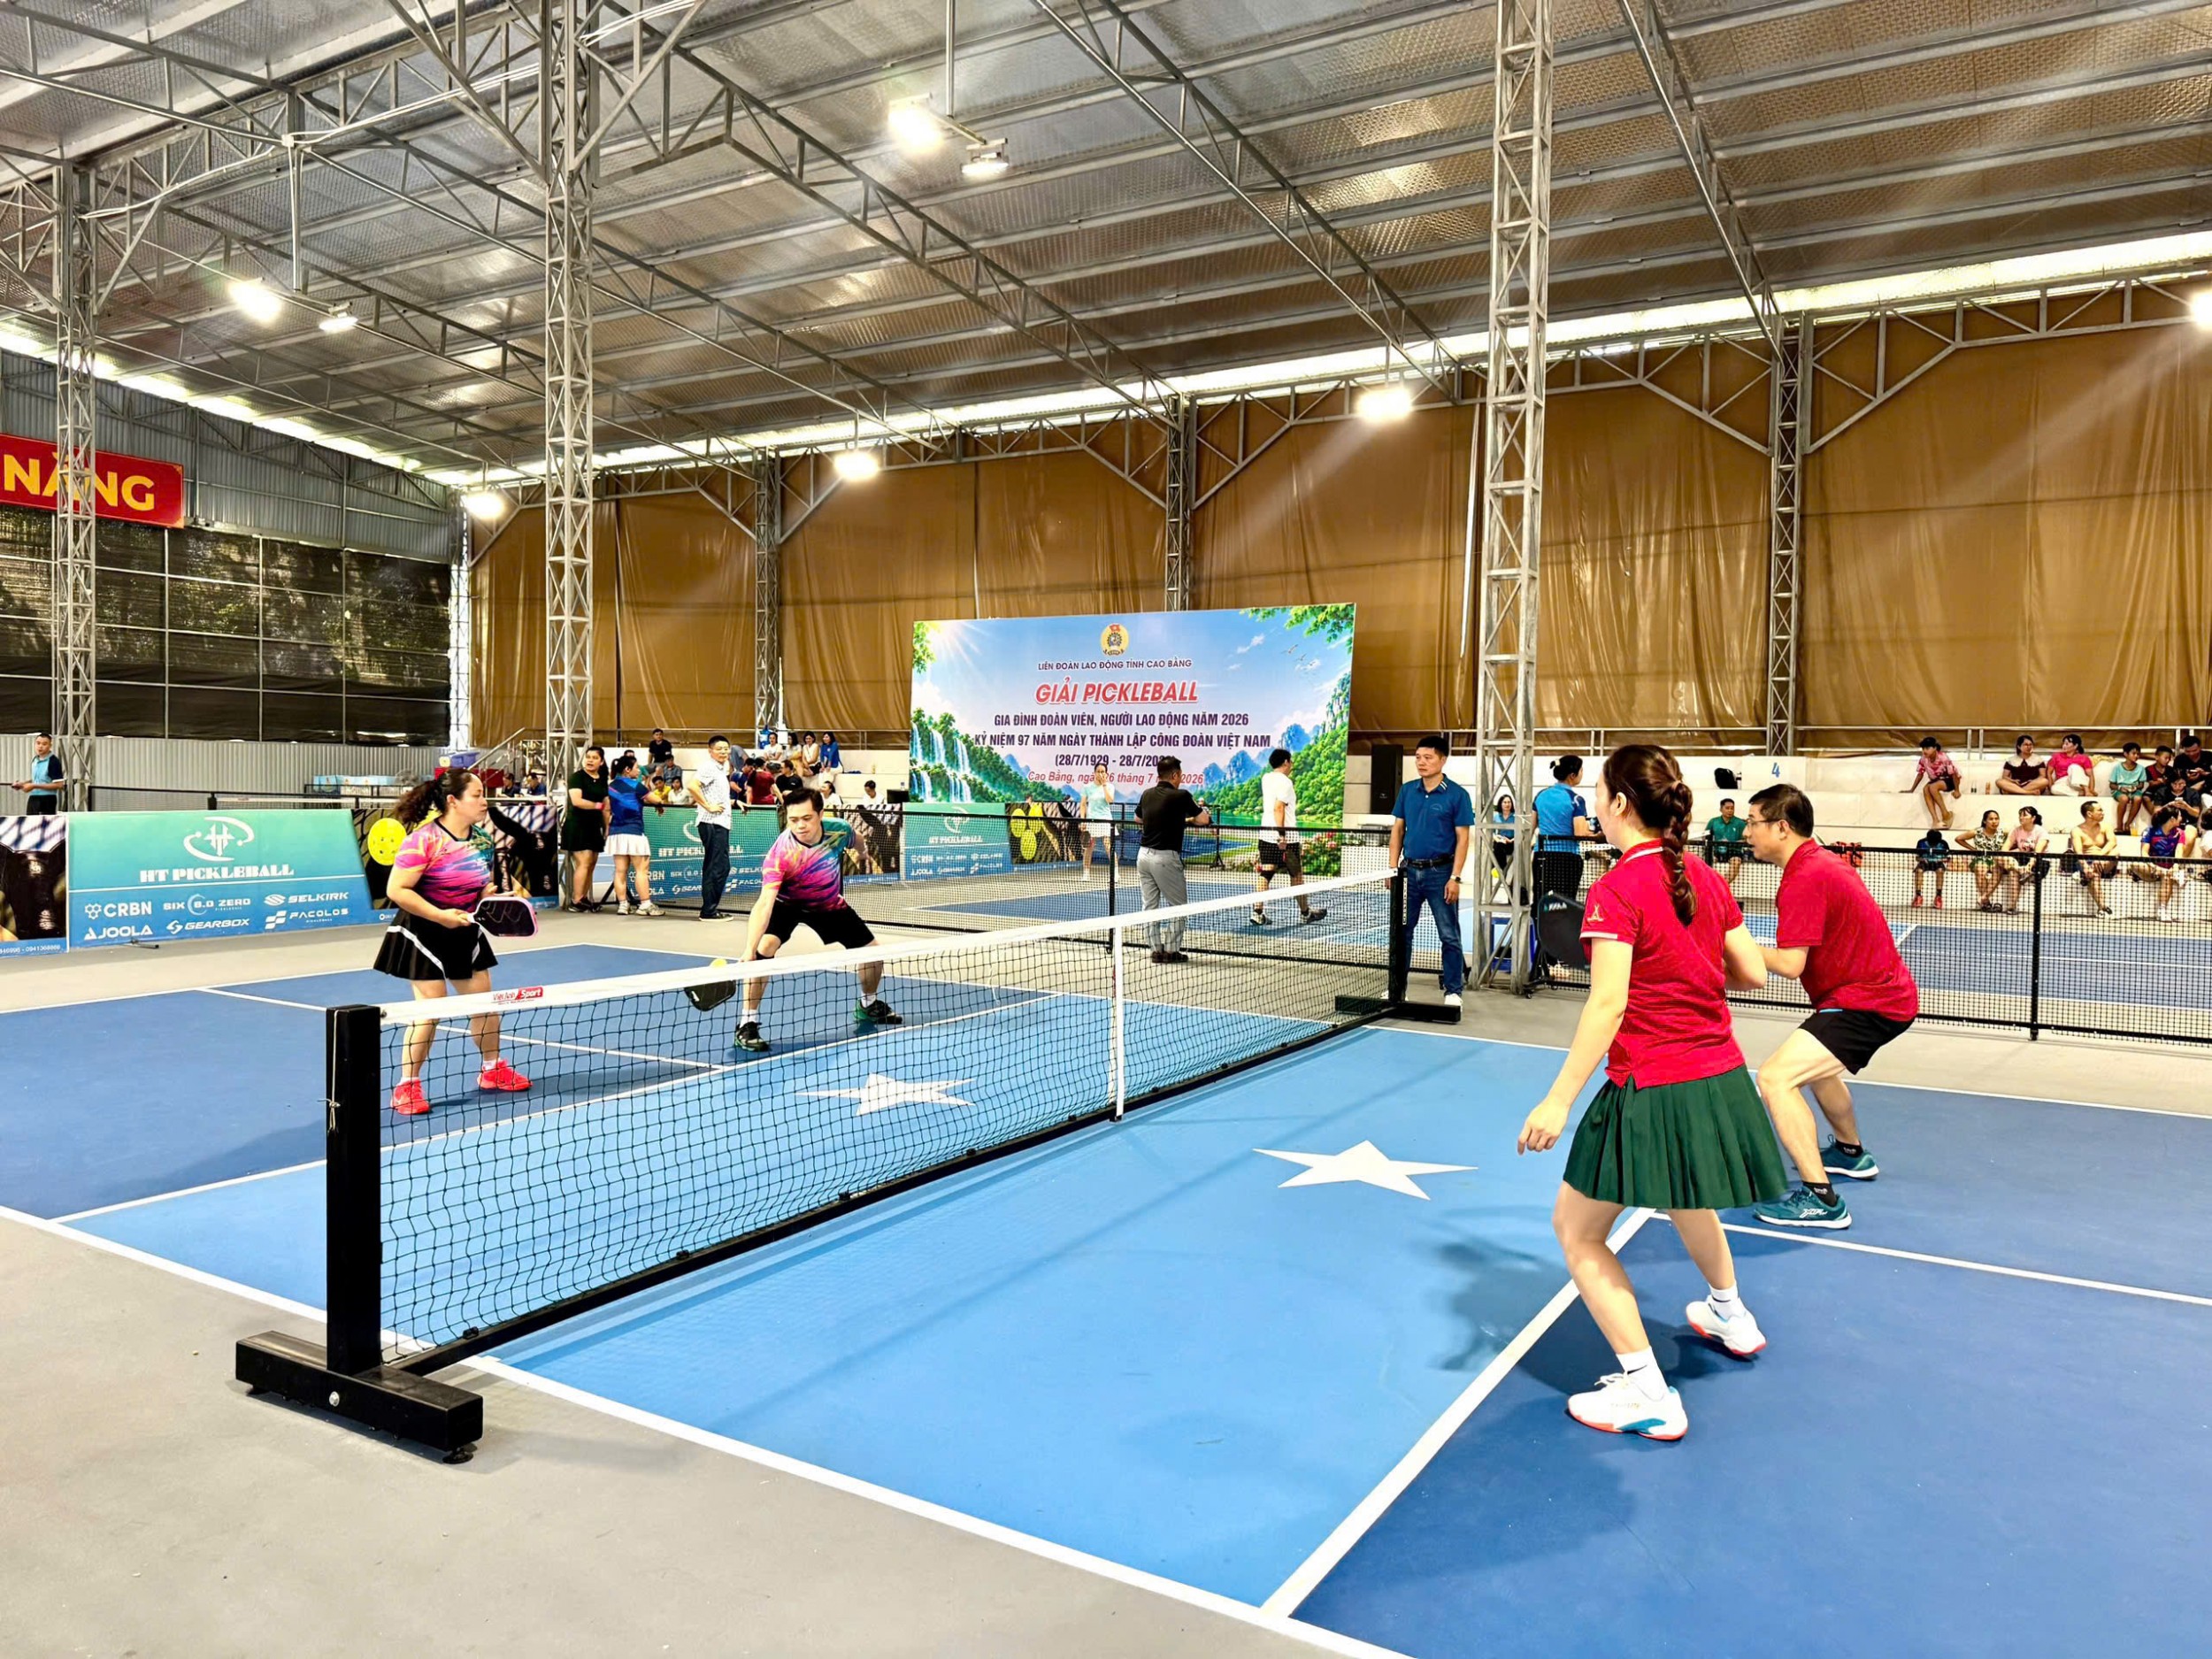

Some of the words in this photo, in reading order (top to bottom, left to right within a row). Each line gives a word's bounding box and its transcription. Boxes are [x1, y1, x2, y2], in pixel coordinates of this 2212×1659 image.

[1038, 661, 1054, 671] LIÊN
[1056, 660, 1079, 670] ĐOÀN
[1099, 659, 1124, 672] ĐỘNG
[1035, 677, 1079, 704] GIẢI
[1083, 681, 1199, 704] PICKLEBALL
[995, 714, 1010, 726] GIA
[1013, 711, 1037, 726] ĐÌNH
[1040, 711, 1067, 726] ĐOÀN
[1071, 711, 1097, 727] VIÊN,
[1101, 710, 1133, 726] NGƯỜI
[1136, 714, 1156, 726] LAO
[1158, 711, 1188, 728] ĐỘNG
[1192, 711, 1218, 726] NĂM
[1221, 713, 1248, 726] 2026
[974, 730, 987, 746] KỶ
[990, 732, 1015, 748] NIỆM
[1018, 734, 1030, 746] 97
[1033, 733, 1056, 746] NĂM
[1059, 733, 1087, 747] NGÀY
[1090, 733, 1124, 747] THÀNH
[1126, 732, 1147, 749] LẬP
[1150, 733, 1179, 747] CÔNG
[1183, 733, 1213, 748] ĐOÀN
[1217, 733, 1240, 749] VIỆT
[1244, 734, 1271, 748] NAM
[1771, 762, 1780, 778] 4
[1028, 772, 1045, 781] Cao
[1078, 772, 1095, 784] ngà
[1118, 772, 1145, 785] tháng
[1148, 773, 1154, 783] 7
[1180, 773, 1203, 784] 2026
[140, 869, 169, 883] HT
[173, 864, 295, 881] PICKLEBALL
[163, 902, 185, 910] SIX
[219, 898, 250, 907] ZERO
[288, 892, 349, 904] SELKIRK
[104, 901, 152, 918] CRBN
[289, 908, 349, 919] FACOLOS
[185, 918, 250, 931] GEARBOX
[97, 925, 153, 940] JOOLA
[520, 989, 541, 999] Sport
